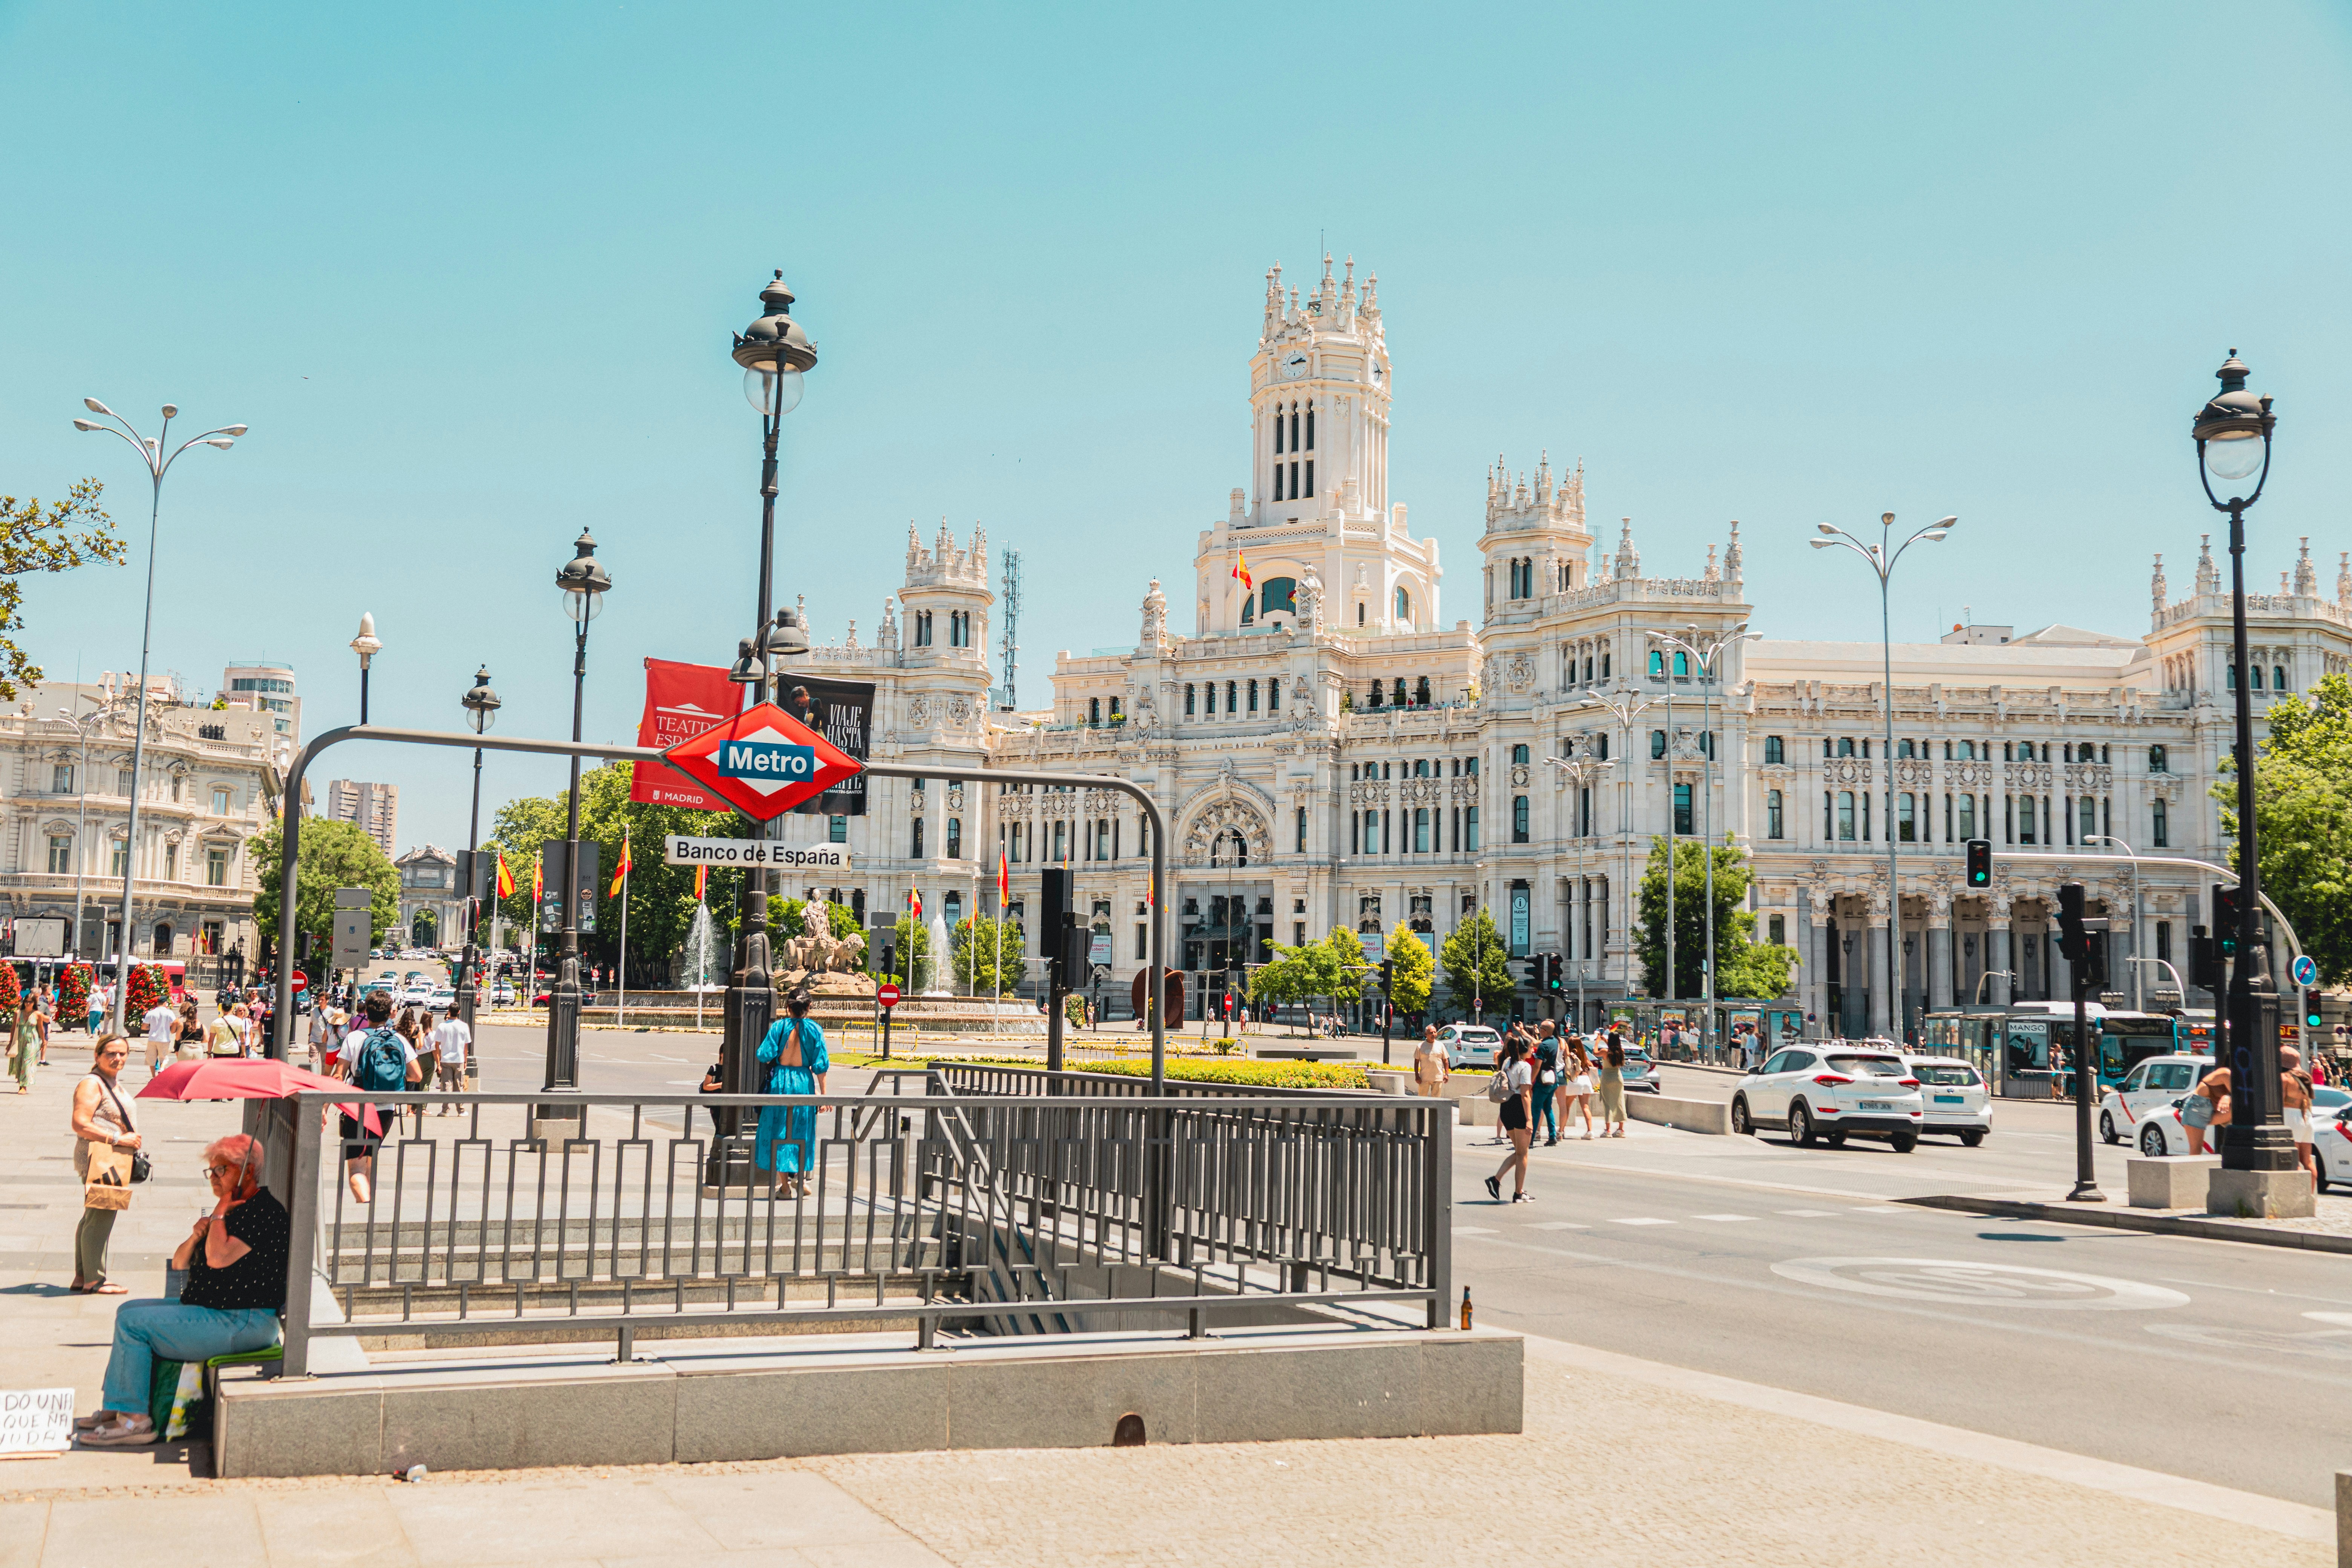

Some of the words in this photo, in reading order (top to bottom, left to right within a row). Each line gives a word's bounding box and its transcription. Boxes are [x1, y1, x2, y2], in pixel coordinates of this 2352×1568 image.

[830, 704, 862, 727] VIAJE
[827, 725, 862, 748] HASTA
[729, 746, 807, 774] Metro
[665, 792, 703, 804] MADRID
[677, 841, 737, 861] Banco
[743, 845, 766, 862] de
[773, 847, 840, 867] España
[38, 1393, 72, 1411] UNA
